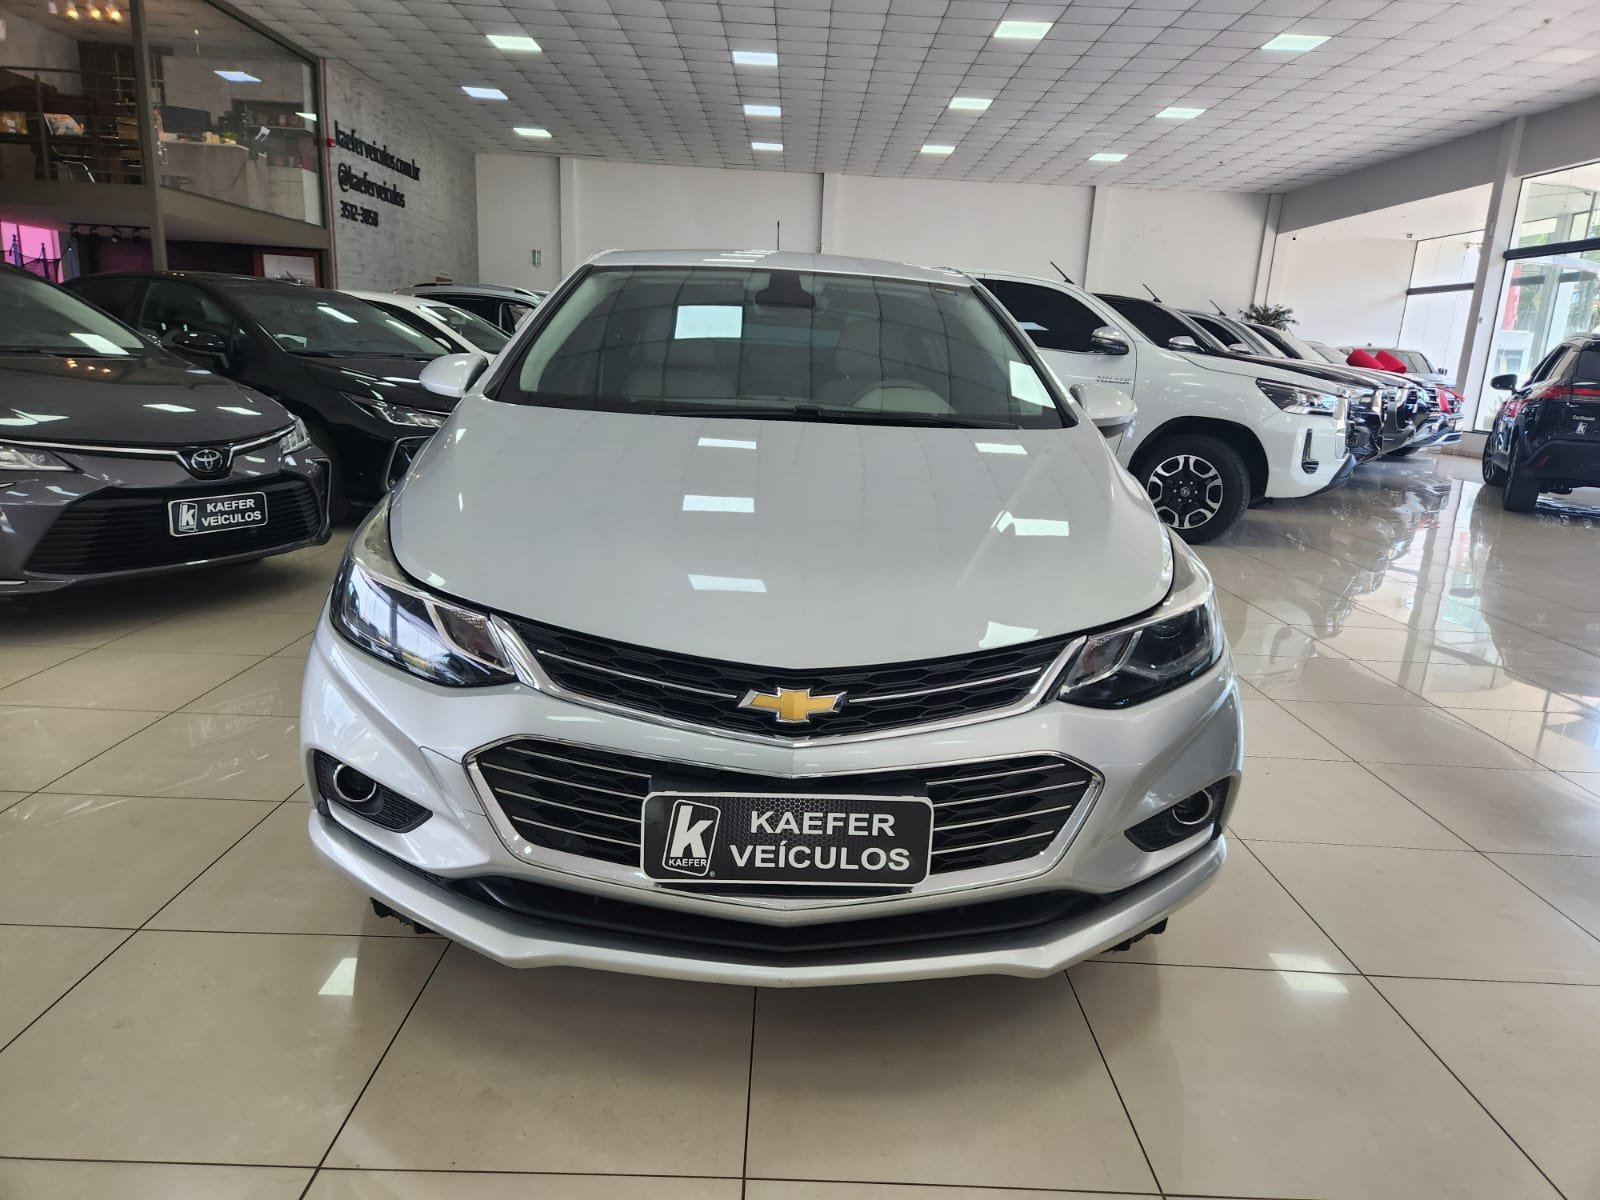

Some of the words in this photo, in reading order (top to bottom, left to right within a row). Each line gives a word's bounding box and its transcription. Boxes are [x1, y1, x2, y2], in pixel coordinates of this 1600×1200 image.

[206, 499, 255, 513] KAEFER
[201, 511, 262, 527] VEÍCULOS
[750, 811, 896, 837] KAEFER
[668, 858, 708, 867] KAEFER
[730, 840, 911, 871] VEÍCULOS
